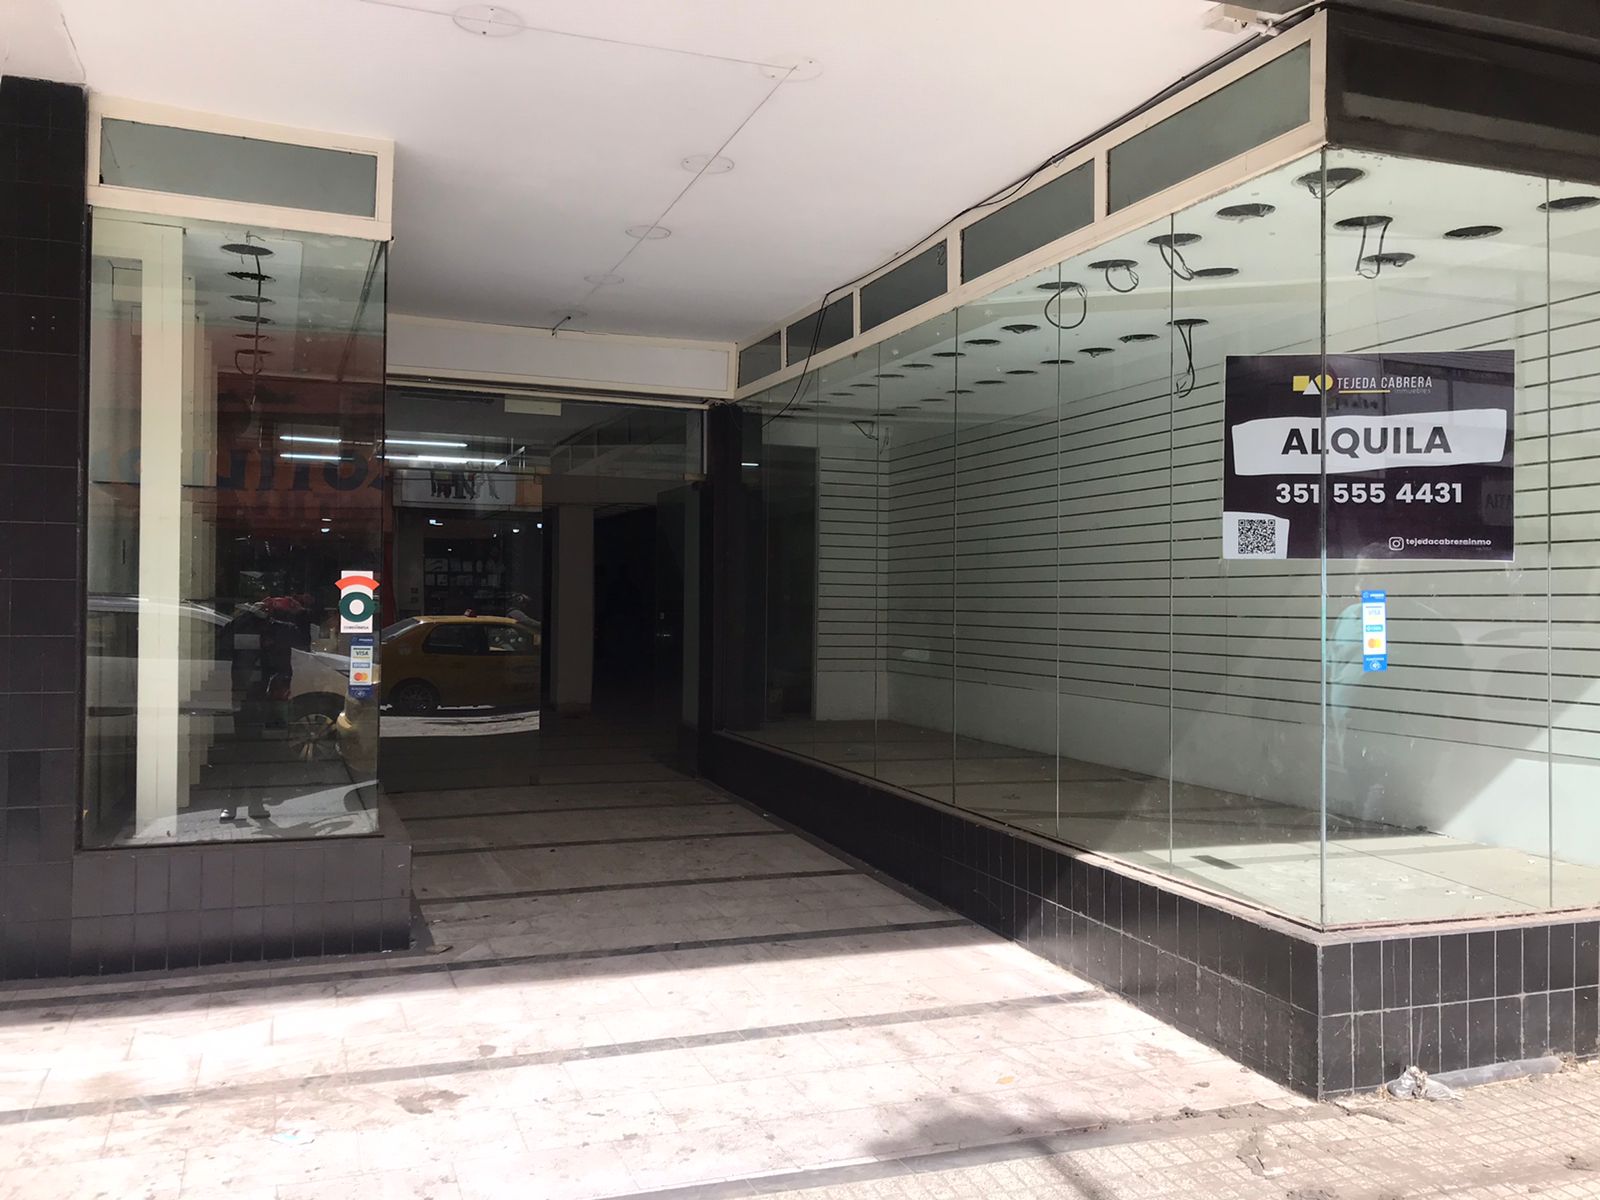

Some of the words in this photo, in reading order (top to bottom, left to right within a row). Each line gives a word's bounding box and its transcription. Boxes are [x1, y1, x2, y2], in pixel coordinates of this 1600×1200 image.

[1336, 377, 1377, 389] TEJEDA
[1380, 376, 1433, 389] CABRERA
[1280, 426, 1452, 459] ALQUILA
[1275, 483, 1320, 504] 351
[1333, 483, 1386, 504] 555
[1395, 482, 1463, 504] 4431
